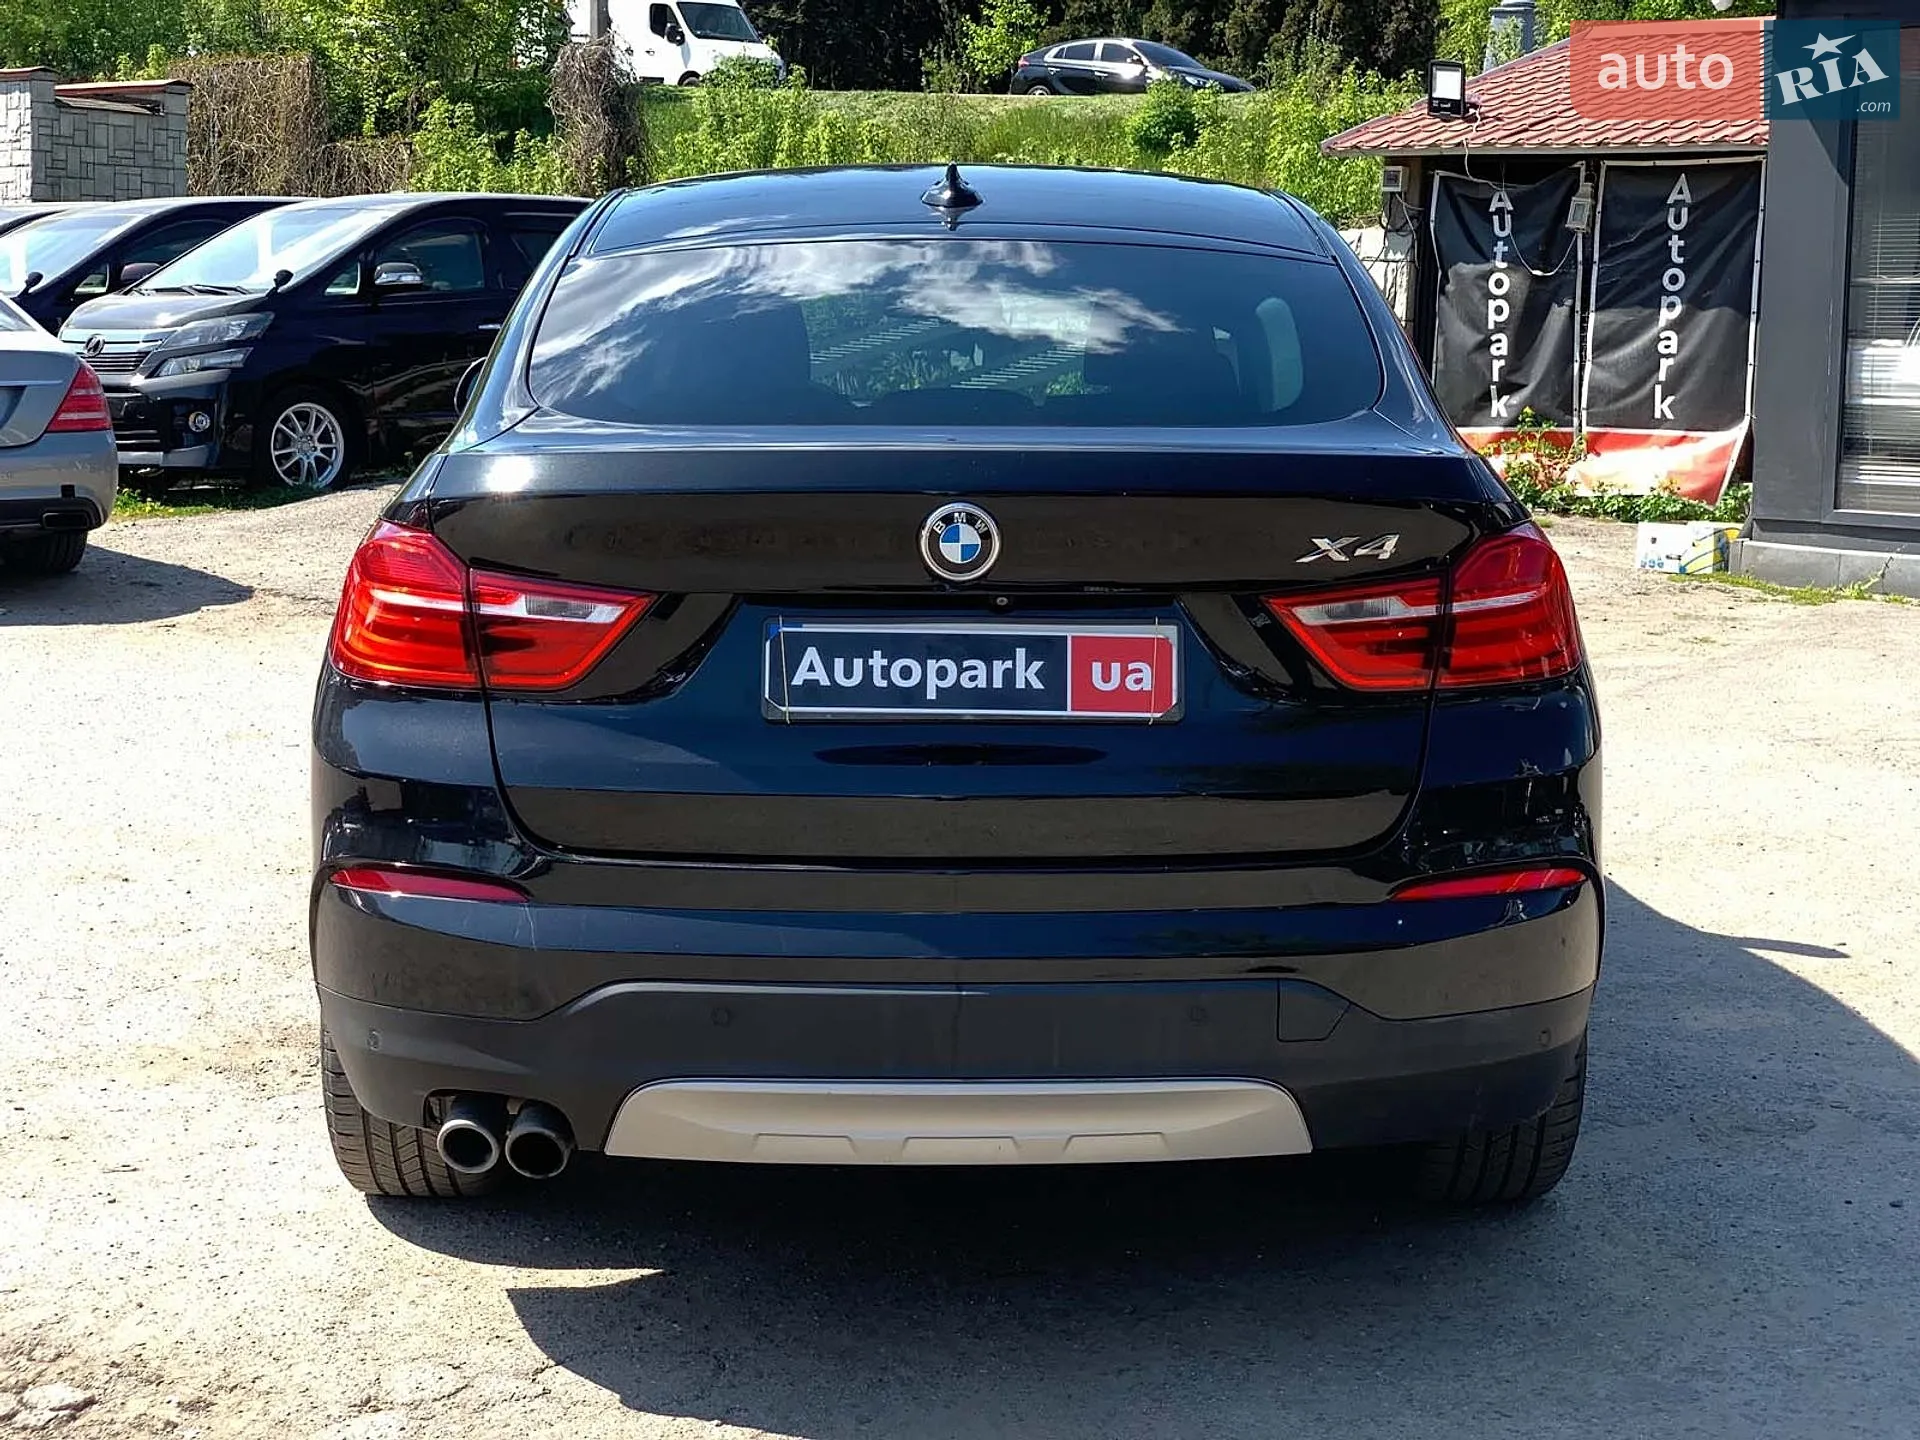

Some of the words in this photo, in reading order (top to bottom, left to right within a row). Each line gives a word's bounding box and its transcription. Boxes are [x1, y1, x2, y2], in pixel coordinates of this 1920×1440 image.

[1486, 191, 1514, 418] Autopark
[1652, 173, 1692, 420] Autopark
[933, 512, 989, 535] BMW
[1295, 533, 1400, 562] X4
[791, 646, 1045, 700] Autopark
[1091, 661, 1153, 692] ua
